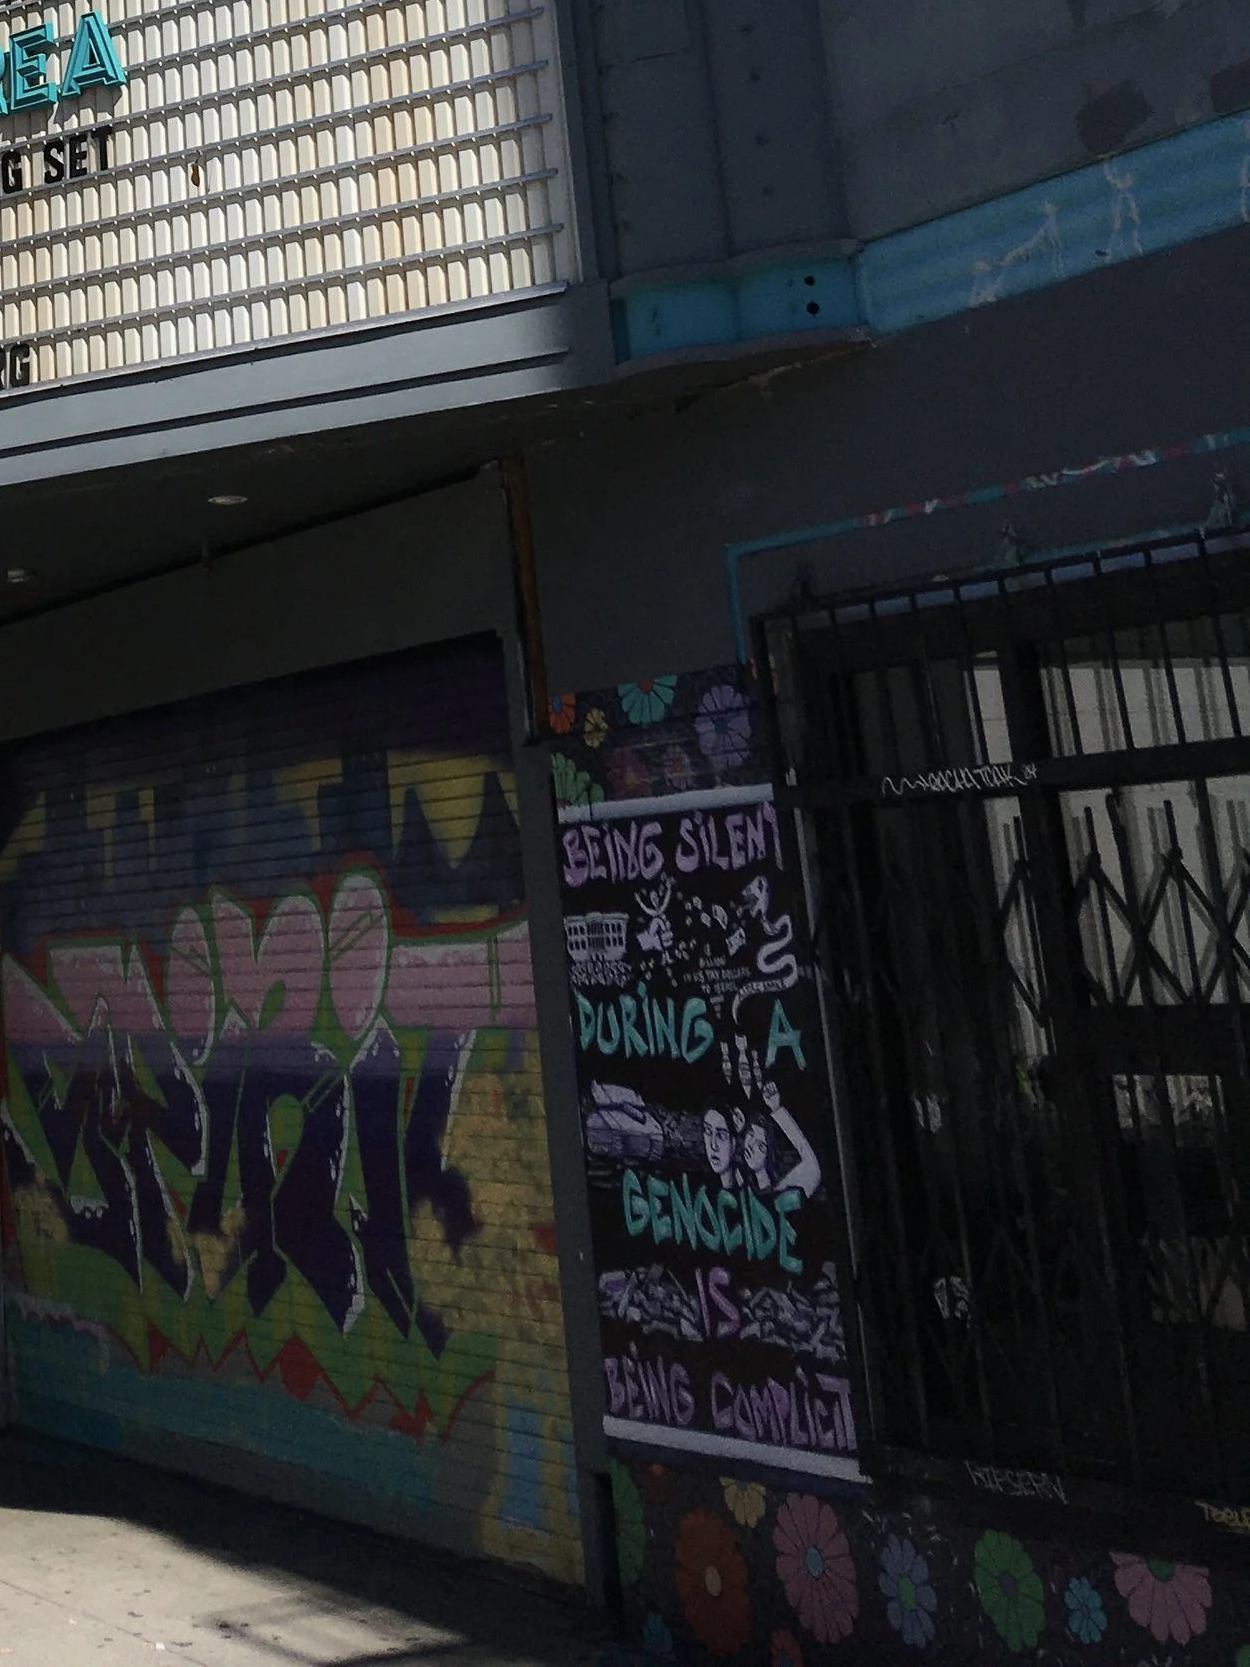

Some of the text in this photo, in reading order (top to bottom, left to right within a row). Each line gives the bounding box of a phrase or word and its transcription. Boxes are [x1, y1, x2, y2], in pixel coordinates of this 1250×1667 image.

[44, 125, 114, 184] SET
[562, 801, 784, 887] BEING SILENT
[576, 981, 807, 1072] DURING A
[622, 1169, 803, 1275] GENOCIDE
[695, 1266, 741, 1337] IS
[604, 1341, 857, 1450] BEING COMPLICIT
